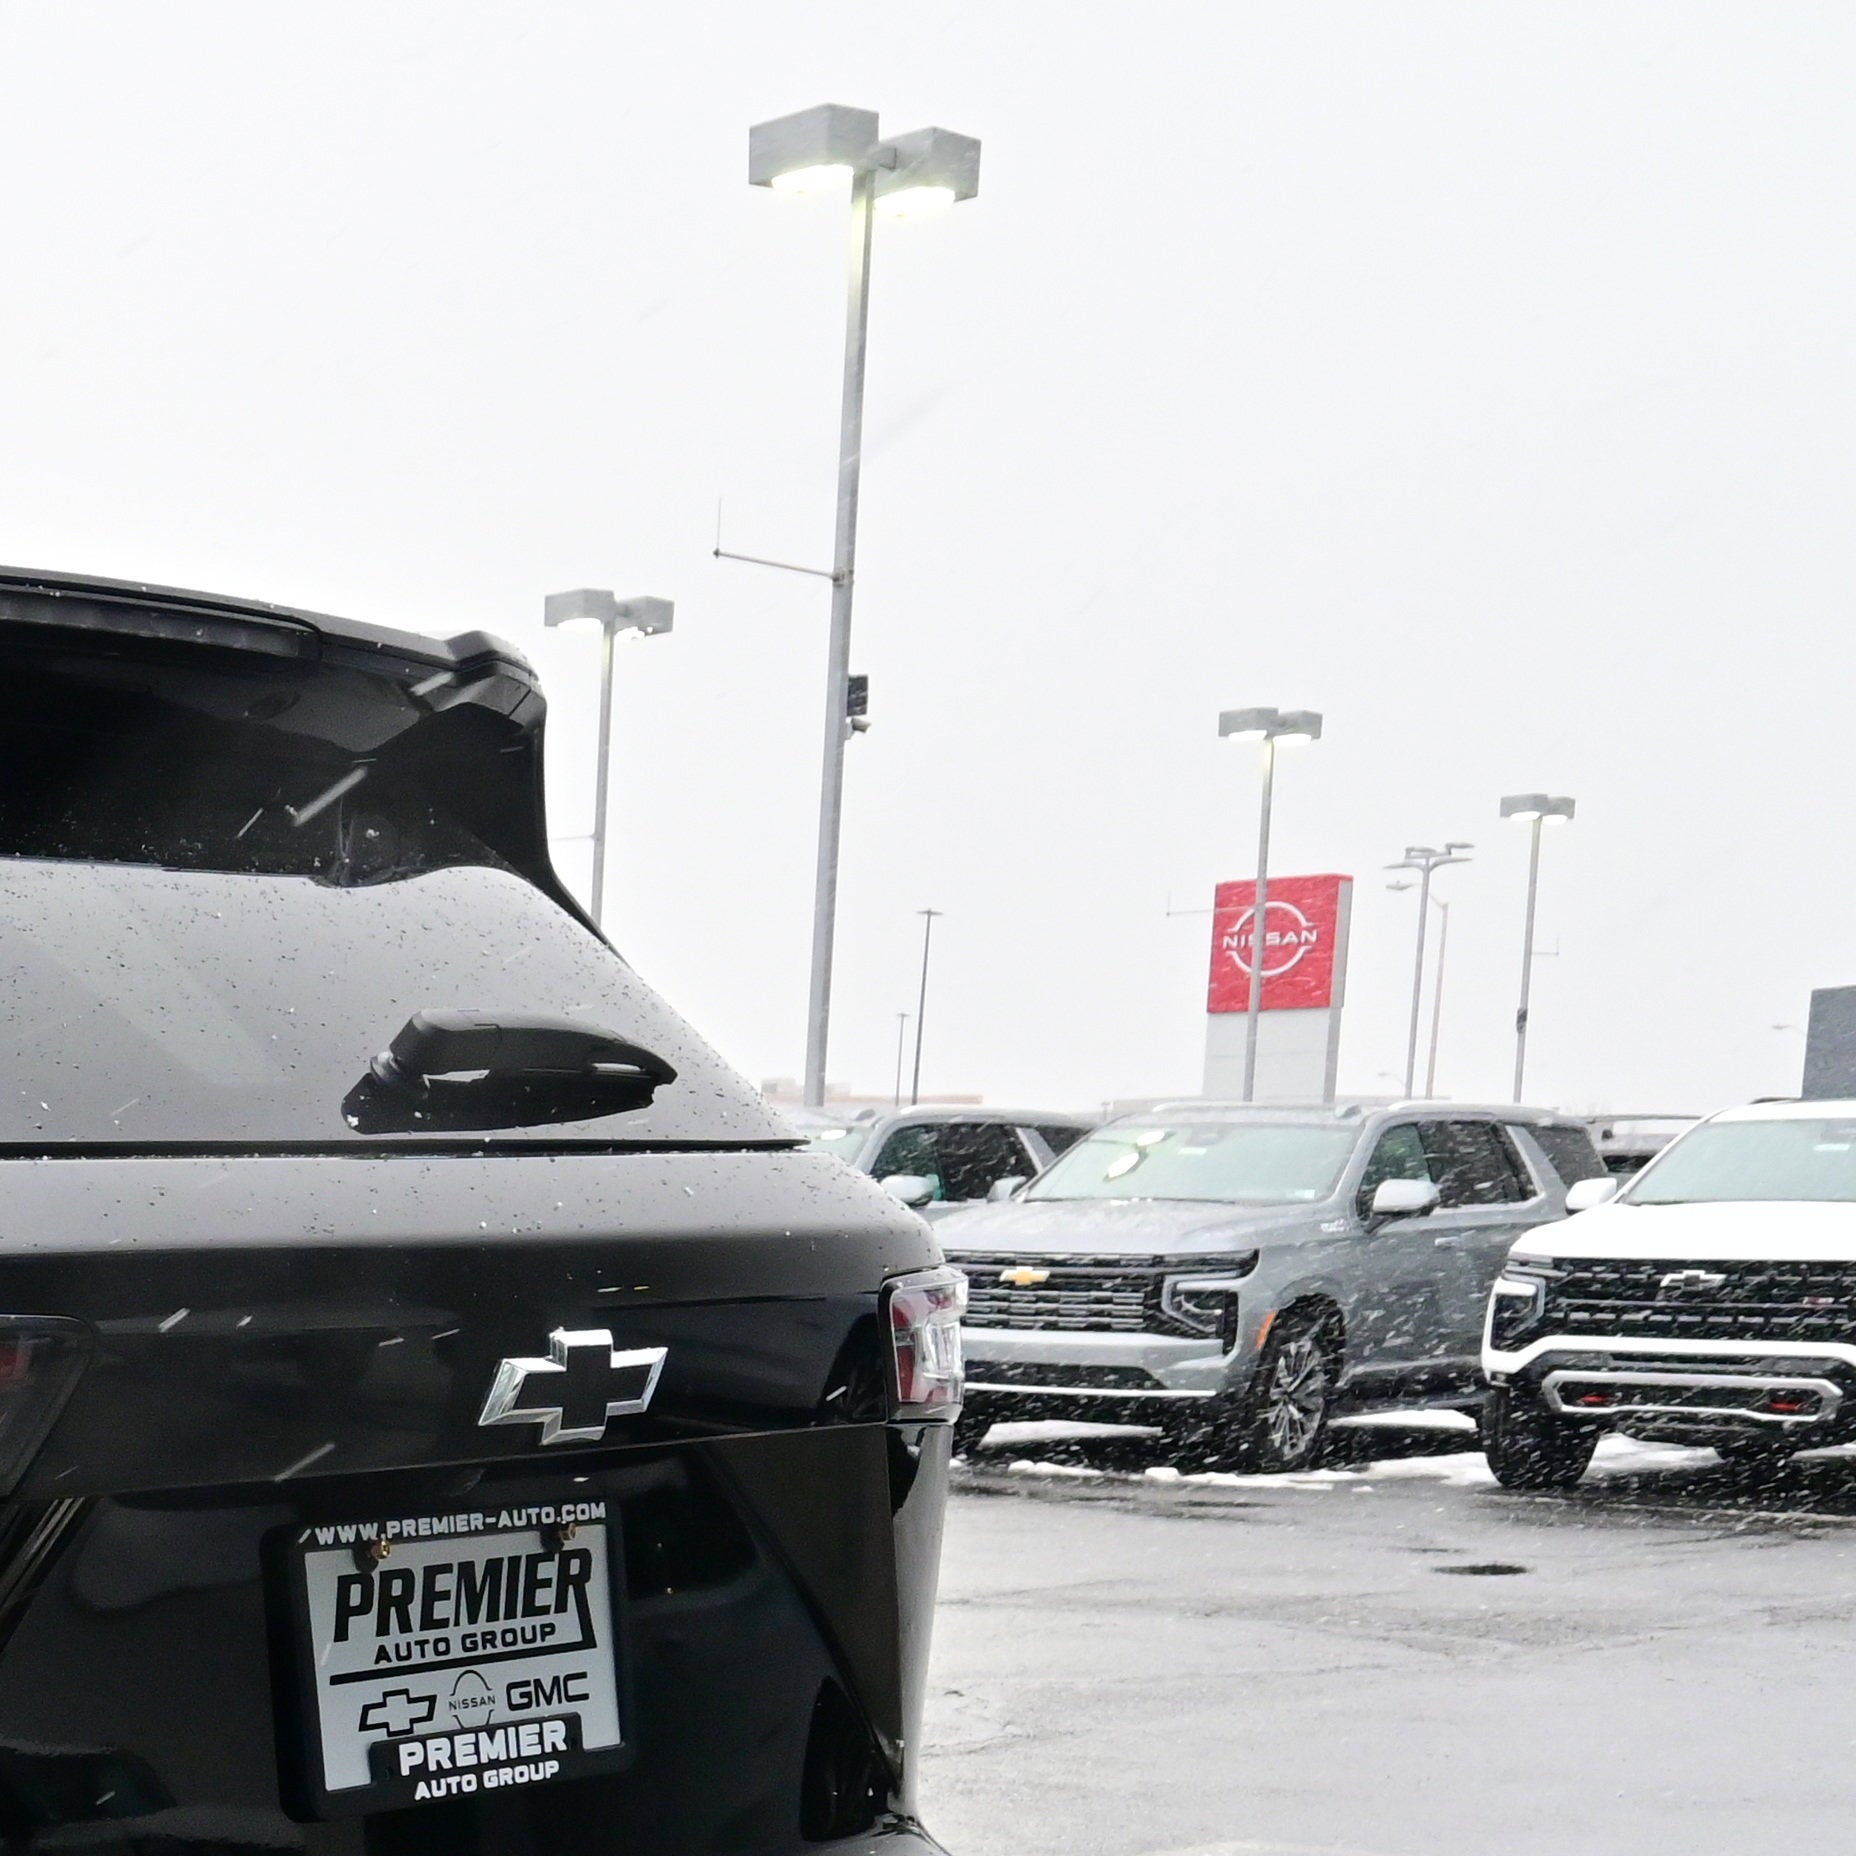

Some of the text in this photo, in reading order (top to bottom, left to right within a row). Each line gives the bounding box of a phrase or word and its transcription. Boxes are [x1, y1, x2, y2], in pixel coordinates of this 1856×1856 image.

[315, 1502, 606, 1545] WWW.PREMIER-AUTO.COM
[333, 1547, 593, 1648] PREMIER
[374, 1622, 556, 1665] AUTO GROUP
[448, 1671, 590, 1711] NISSAN GMC
[398, 1719, 568, 1776] PREMIER
[414, 1760, 560, 1801] AUTO GROUP
